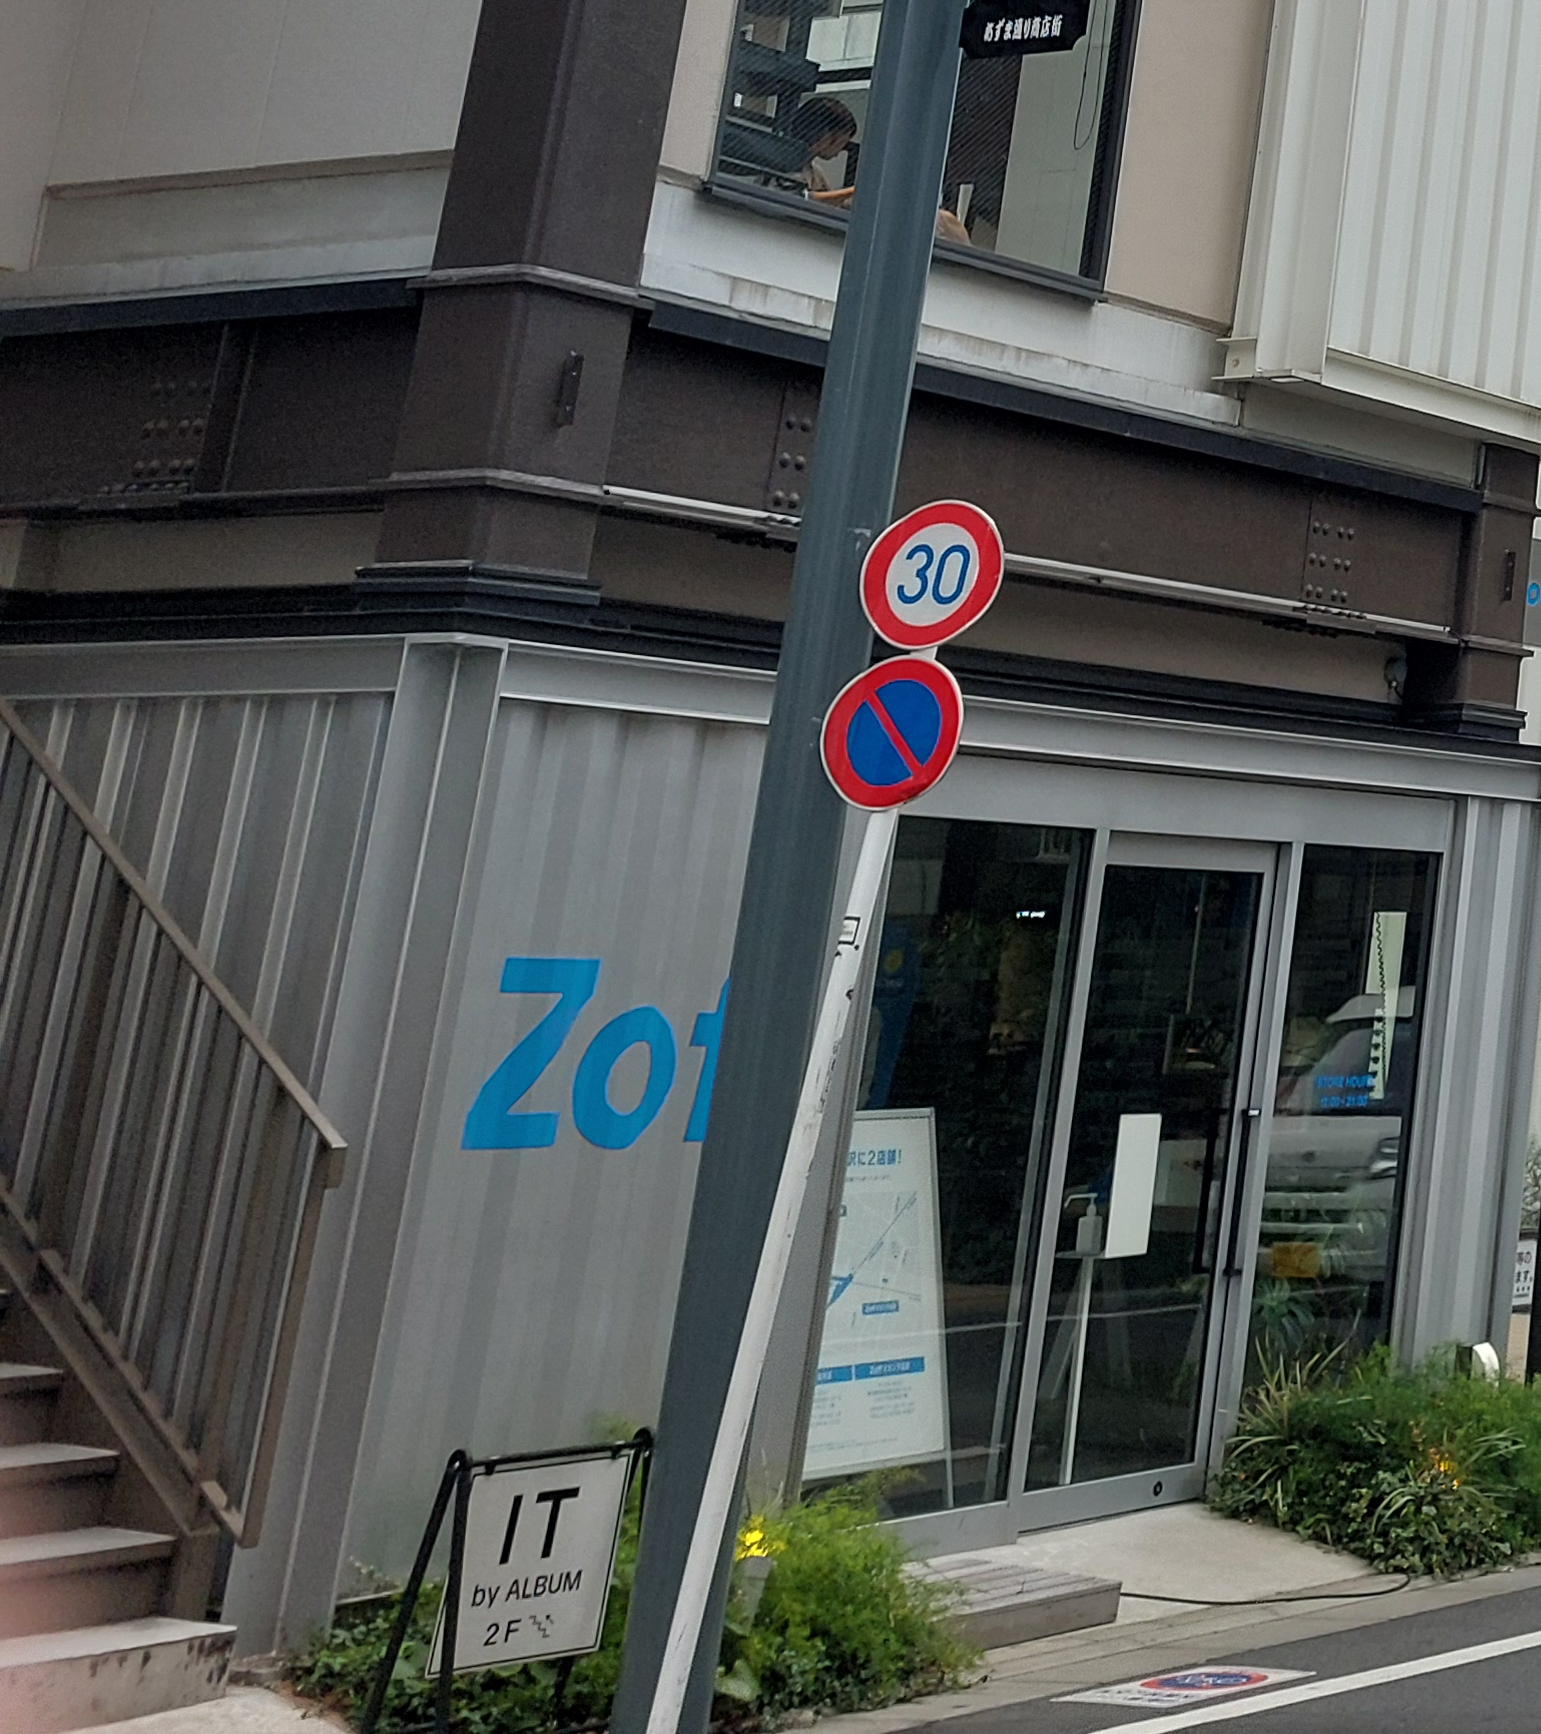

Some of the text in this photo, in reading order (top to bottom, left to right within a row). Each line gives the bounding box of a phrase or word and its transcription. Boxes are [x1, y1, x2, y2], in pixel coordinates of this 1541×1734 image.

[983, 14, 1063, 43] あずま通り商店街
[897, 544, 971, 605] 30
[499, 1486, 582, 1566] IT
[470, 1569, 583, 1609] by ALBUM
[483, 1618, 522, 1647] 2F
